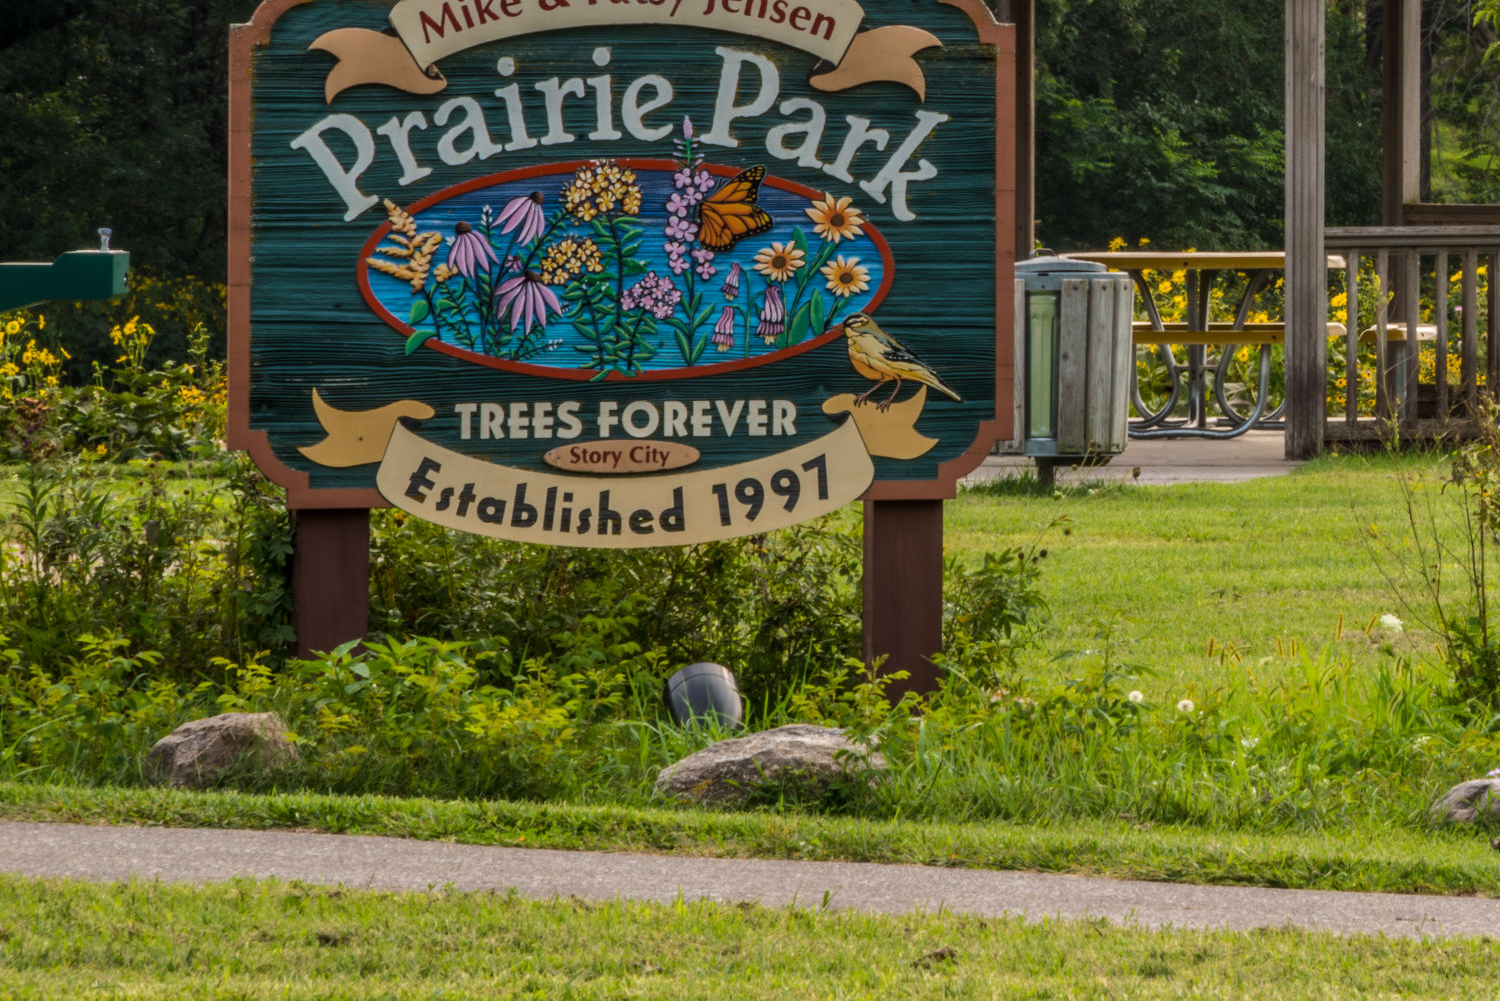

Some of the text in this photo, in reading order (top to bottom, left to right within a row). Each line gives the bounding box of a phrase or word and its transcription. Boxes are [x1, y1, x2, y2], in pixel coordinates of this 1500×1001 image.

[290, 46, 950, 222] Prairie Park
[455, 400, 797, 440] TREES FOREVER
[569, 443, 671, 468] Story City
[404, 453, 830, 536] Established 1997
